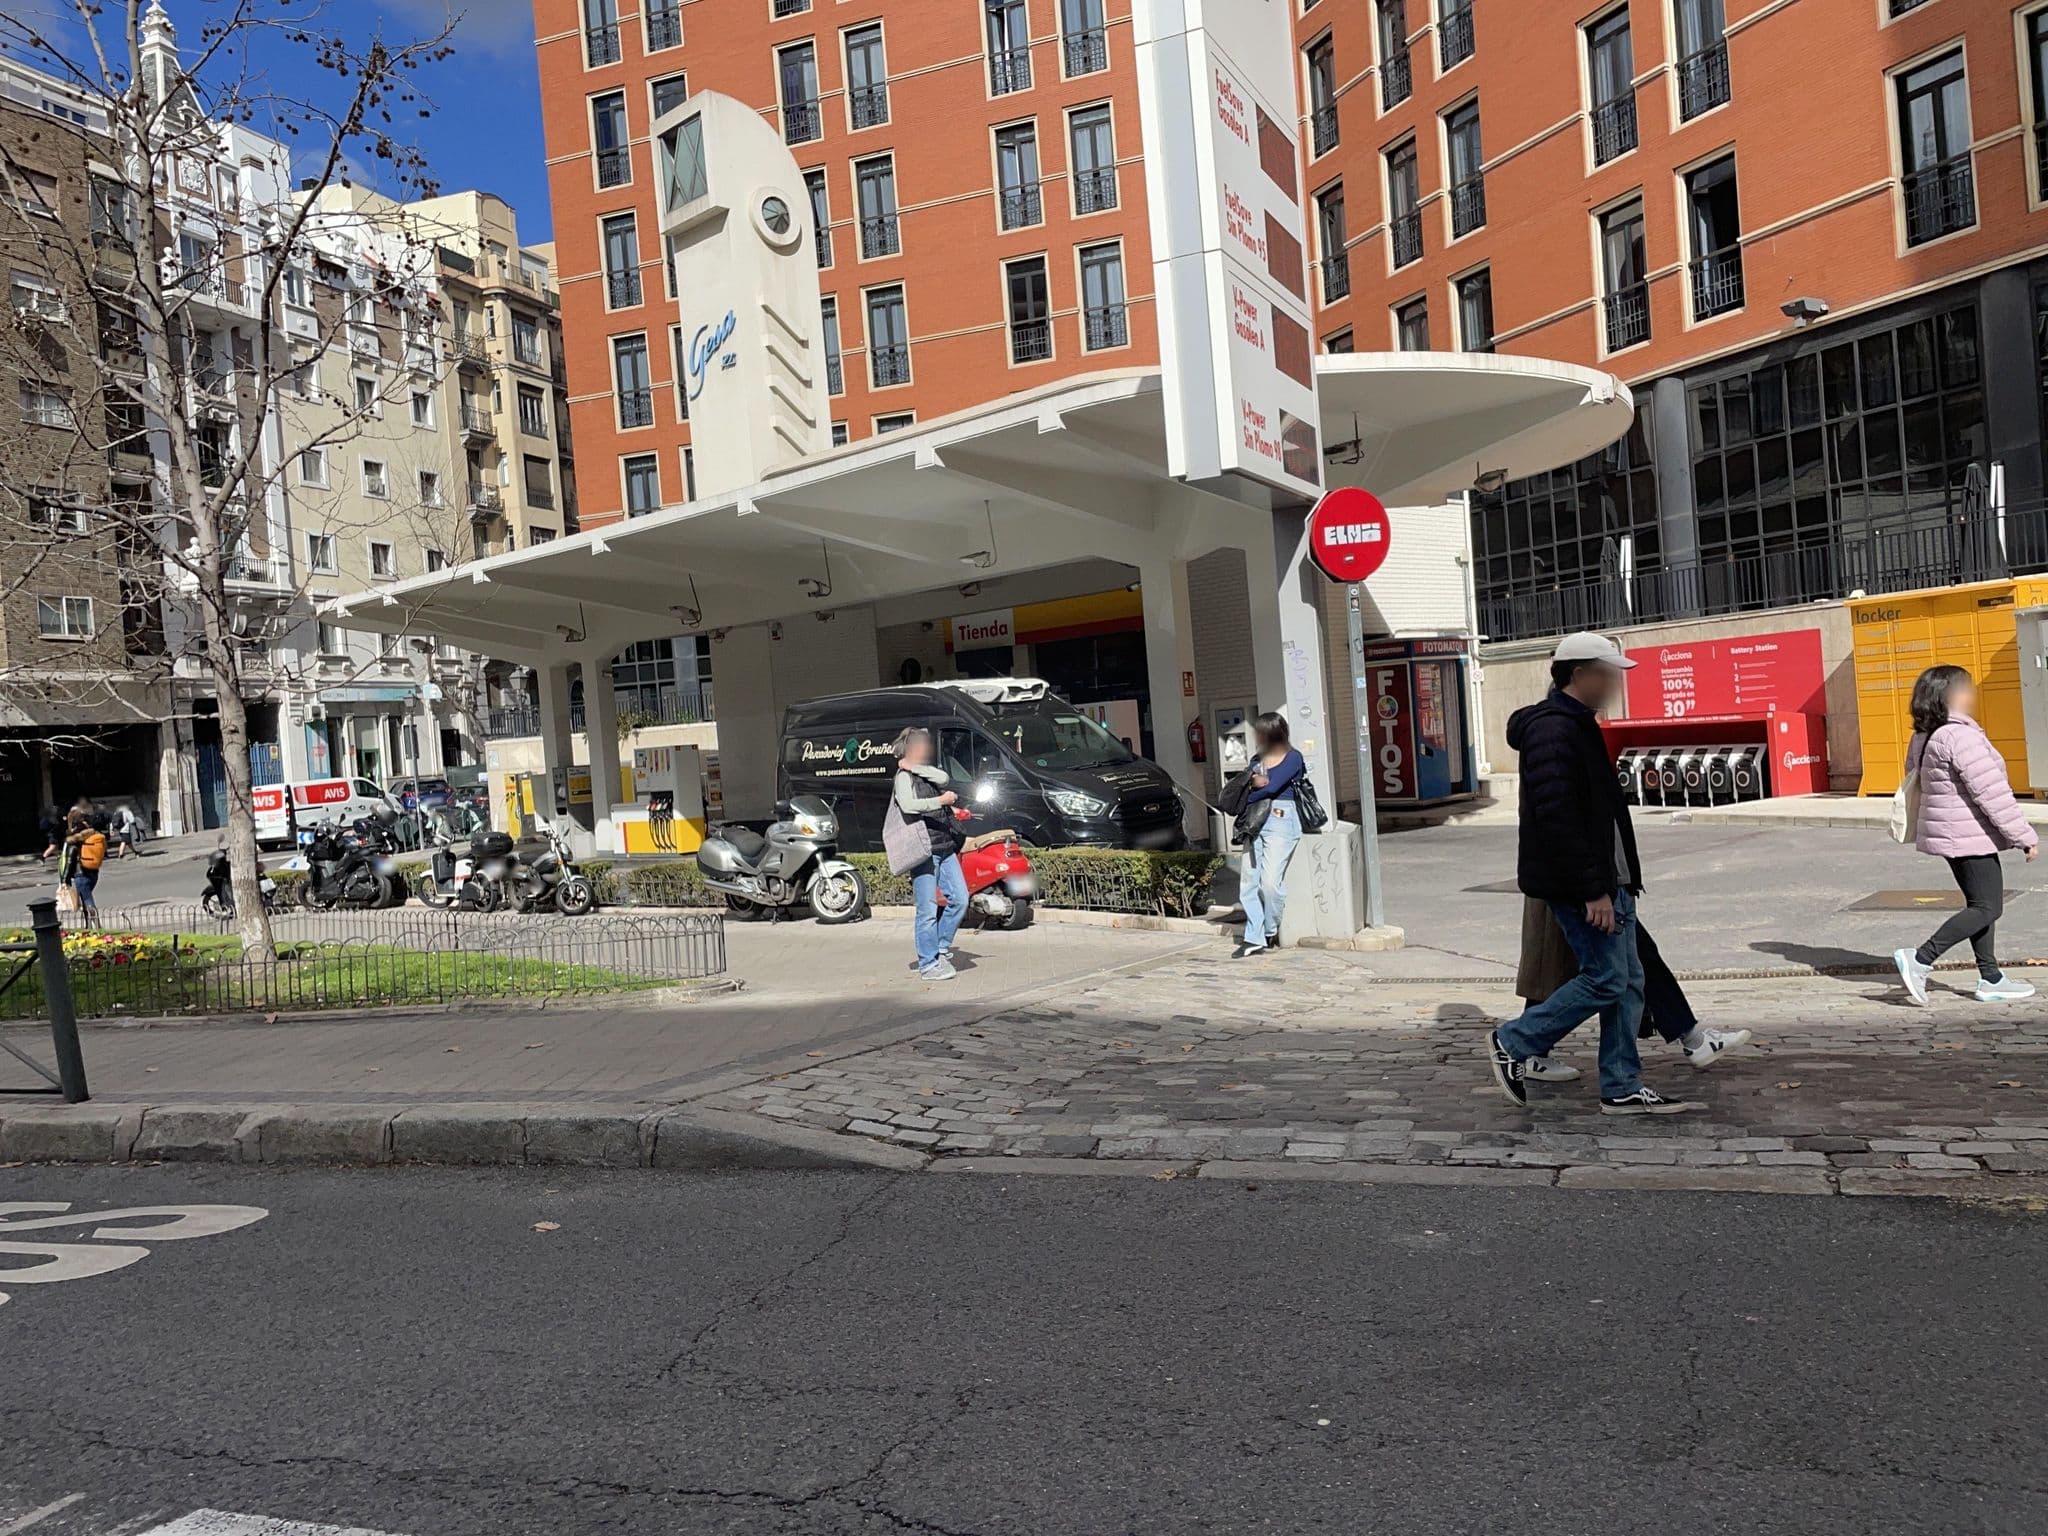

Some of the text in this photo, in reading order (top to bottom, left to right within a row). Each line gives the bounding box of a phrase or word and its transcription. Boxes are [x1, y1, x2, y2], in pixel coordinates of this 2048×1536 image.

[1217, 96, 1250, 147] Gasóleo A
[1226, 211, 1266, 262] Sin Plomo 95
[1232, 285, 1258, 322] V-Power
[1234, 312, 1265, 352] Gasóleo A
[1241, 398, 1266, 431] V-Power
[1243, 425, 1282, 462] Sin Plomo 98
[1855, 607, 1902, 625] locker
[958, 619, 1009, 641] Tienda
[1422, 640, 1464, 653] FOTOMATON
[1730, 643, 1778, 655] Battery Station
[1733, 662, 1738, 670] 1
[1734, 673, 1739, 682] 2
[1662, 678, 1695, 691] 100%
[1735, 685, 1740, 693] 3
[1735, 696, 1741, 704] 4
[1791, 754, 1821, 765] acciona
[324, 787, 346, 800] AVIS
[253, 794, 276, 808] AVIS
